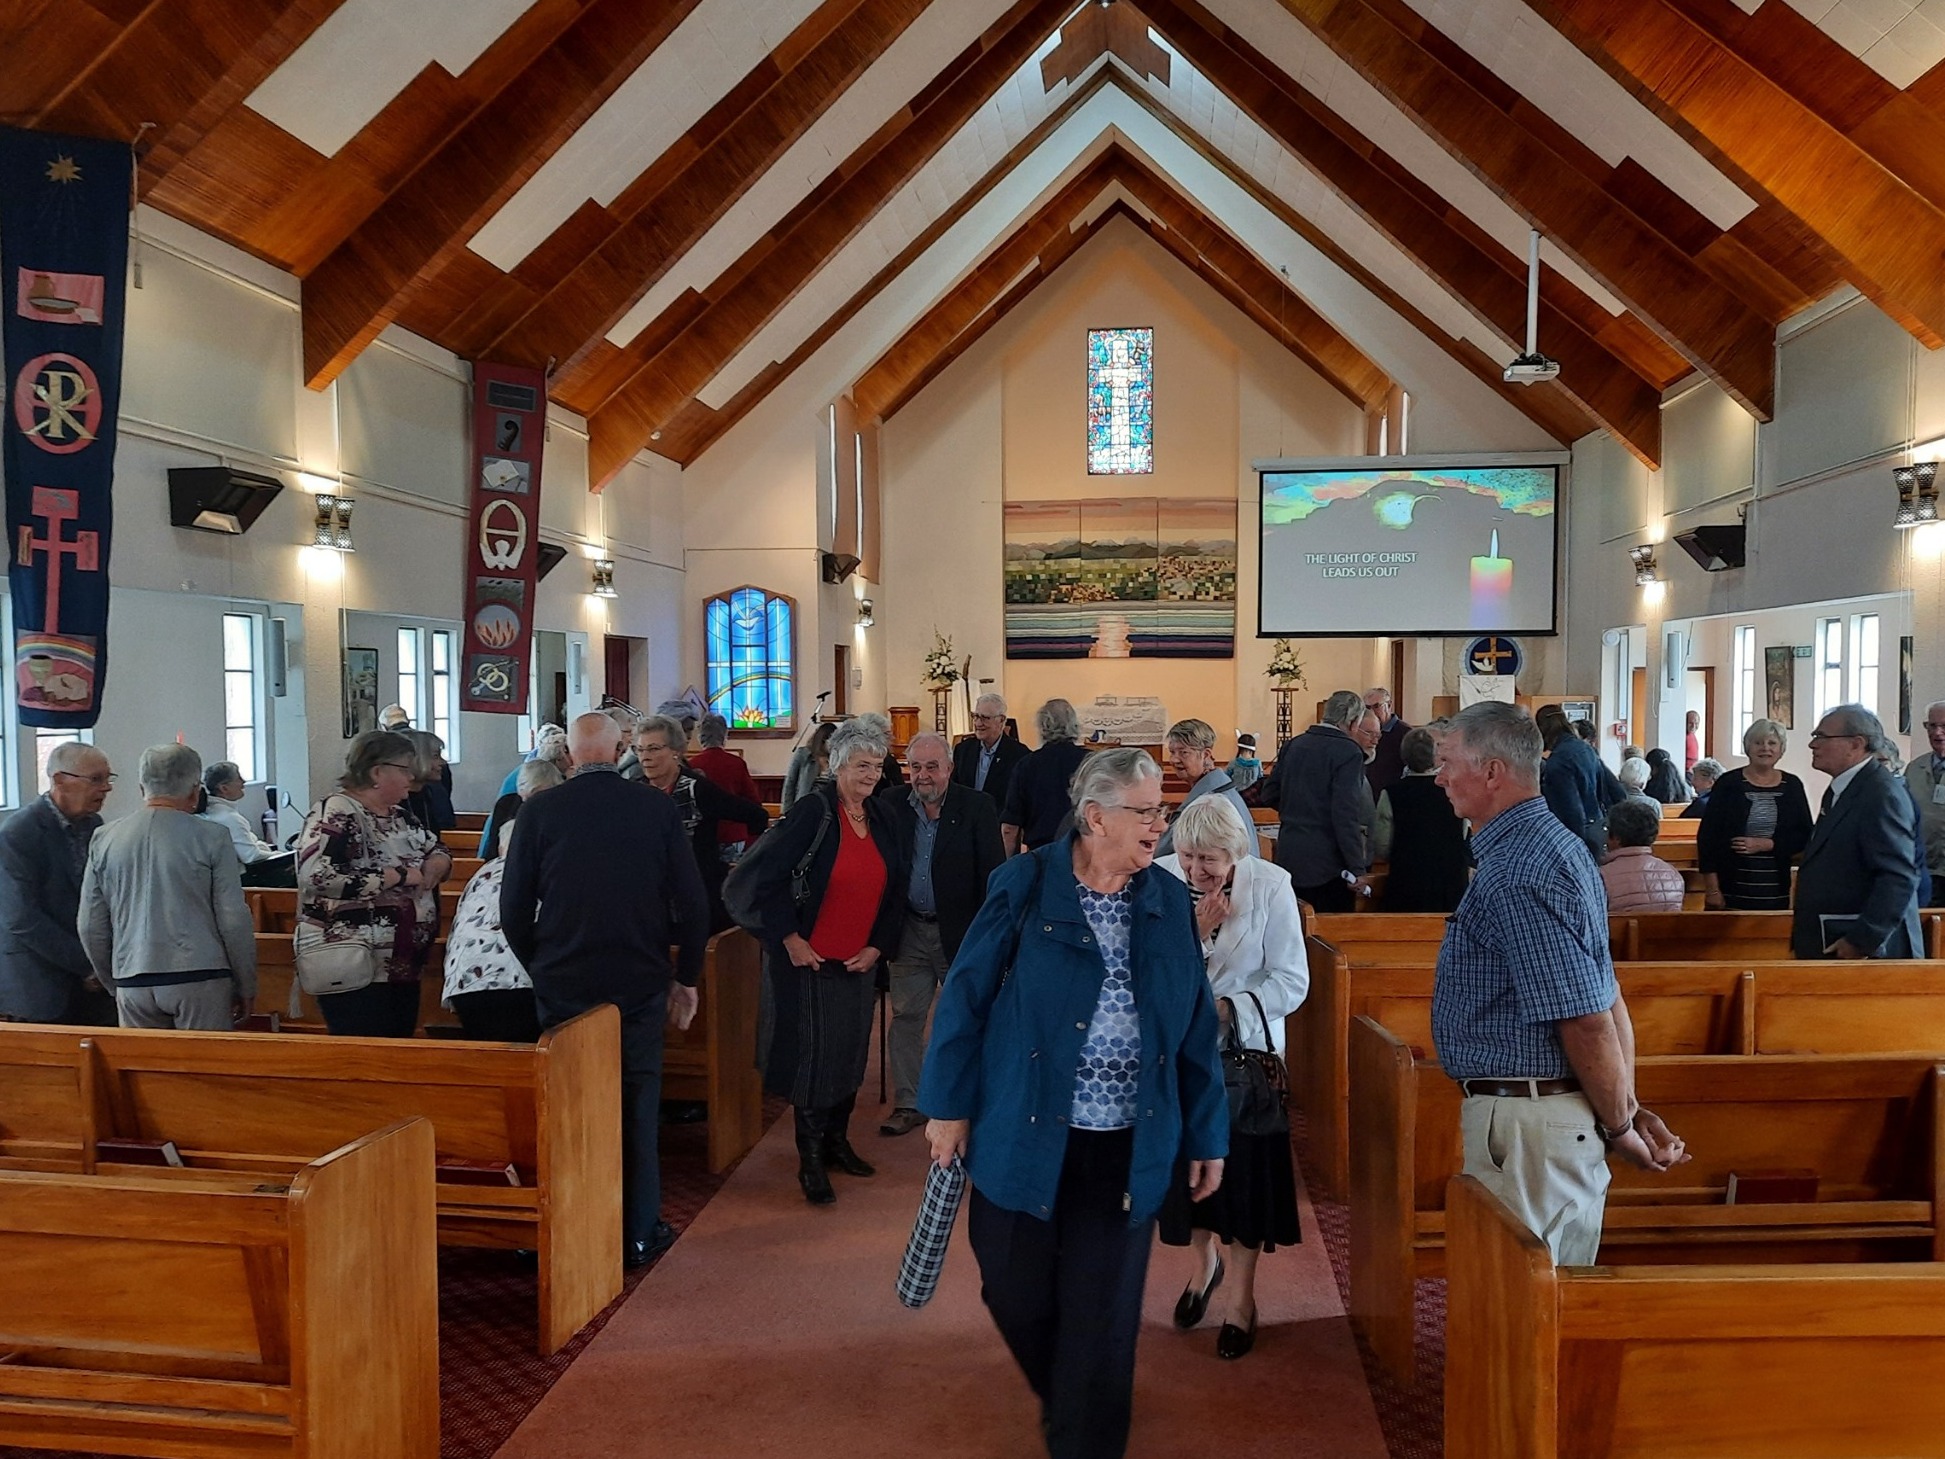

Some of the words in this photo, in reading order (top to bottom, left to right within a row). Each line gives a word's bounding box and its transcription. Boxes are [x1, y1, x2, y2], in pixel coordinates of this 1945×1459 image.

[1304, 553, 1326, 564] THE
[1328, 553, 1360, 564] LIGHT
[1362, 552, 1378, 563] OF
[1379, 552, 1417, 563] CHRIST
[1323, 567, 1356, 578] LEADS
[1358, 567, 1373, 577] US
[1375, 566, 1399, 577] OUT
